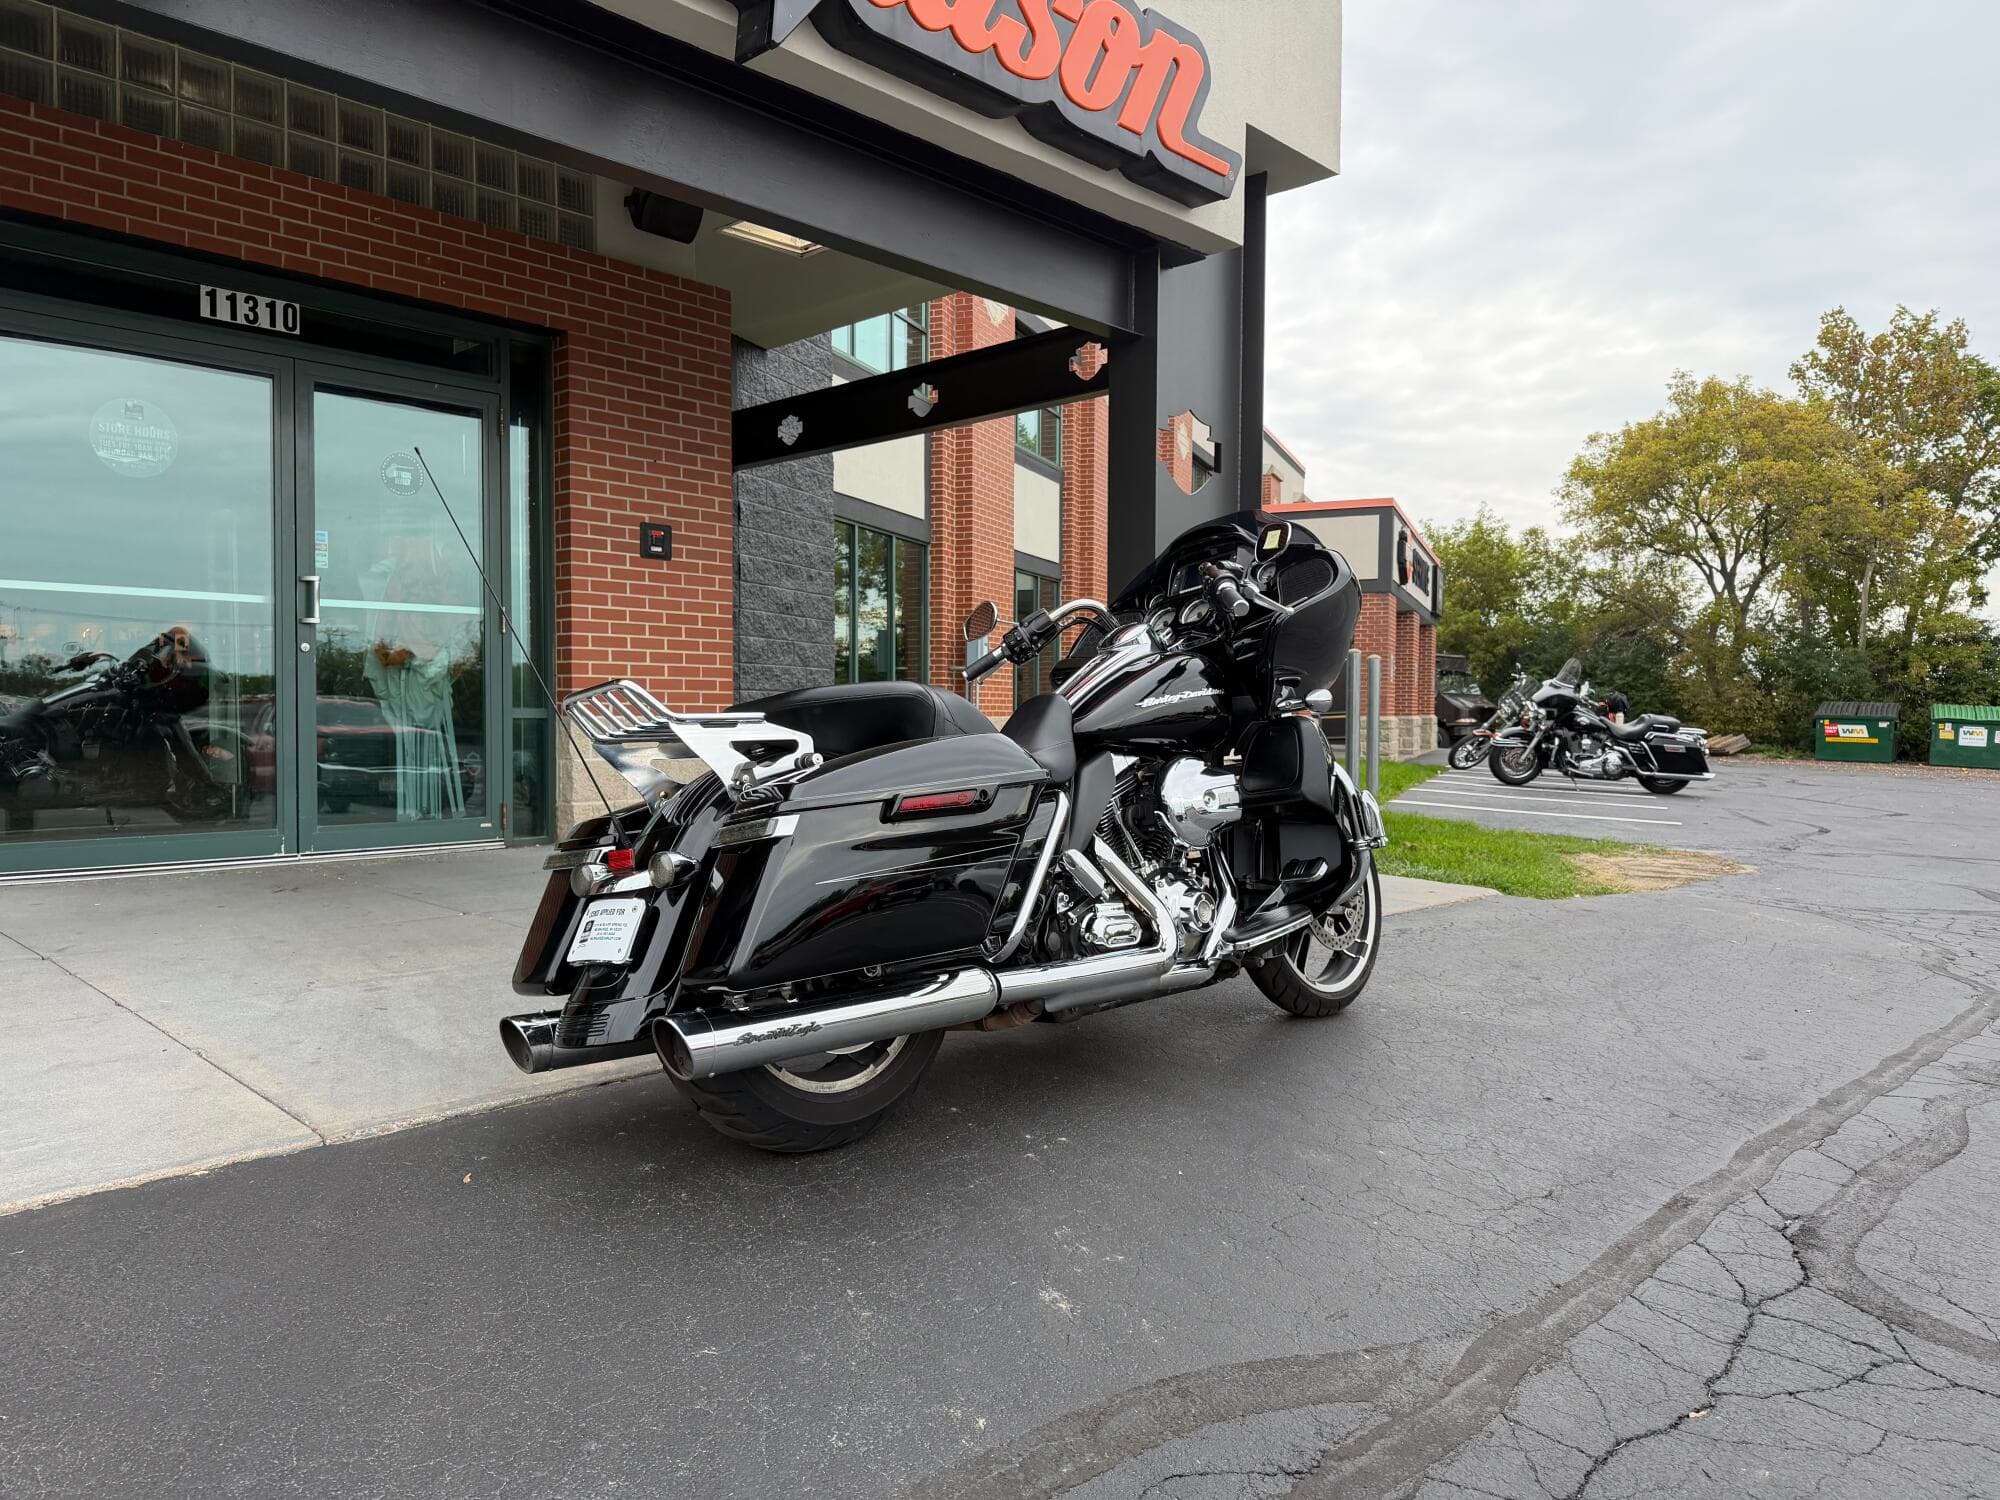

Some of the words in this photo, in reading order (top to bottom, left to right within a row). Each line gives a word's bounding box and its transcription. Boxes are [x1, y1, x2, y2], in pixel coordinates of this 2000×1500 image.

[205, 288, 298, 332] 11310
[98, 422, 131, 436] STORE
[134, 426, 171, 440] HOURS
[615, 908, 626, 916] FOR
